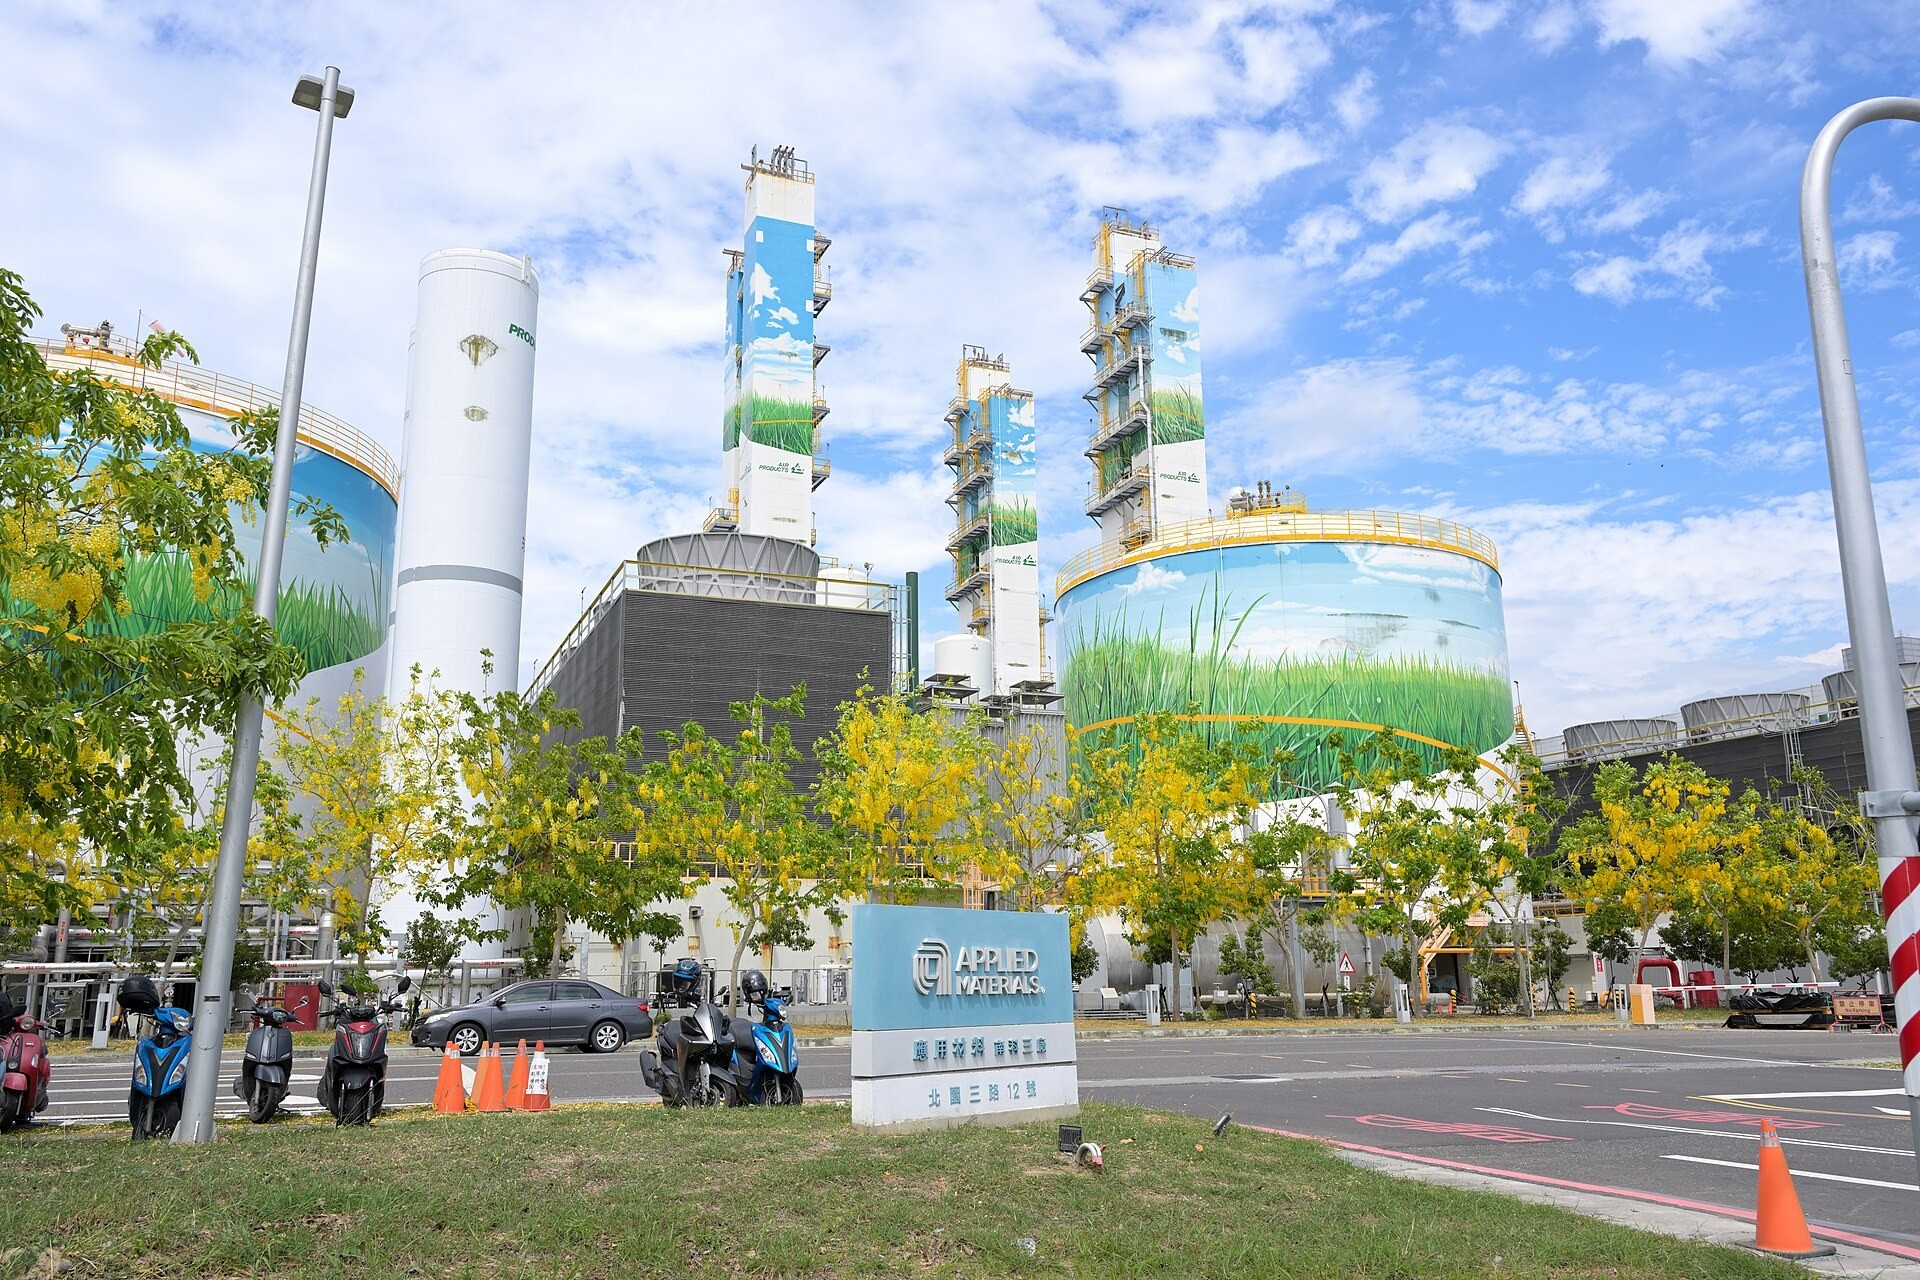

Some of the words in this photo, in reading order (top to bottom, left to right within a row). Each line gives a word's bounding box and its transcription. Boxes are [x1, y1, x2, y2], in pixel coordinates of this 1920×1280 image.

[508, 323, 536, 351] PROD
[758, 465, 789, 473] PRODUCTS
[1159, 473, 1188, 481] PRODUCTS
[955, 946, 1039, 974] APPLIED
[913, 1036, 985, 1061] 應用材料
[994, 1037, 1047, 1057] 南科三廠
